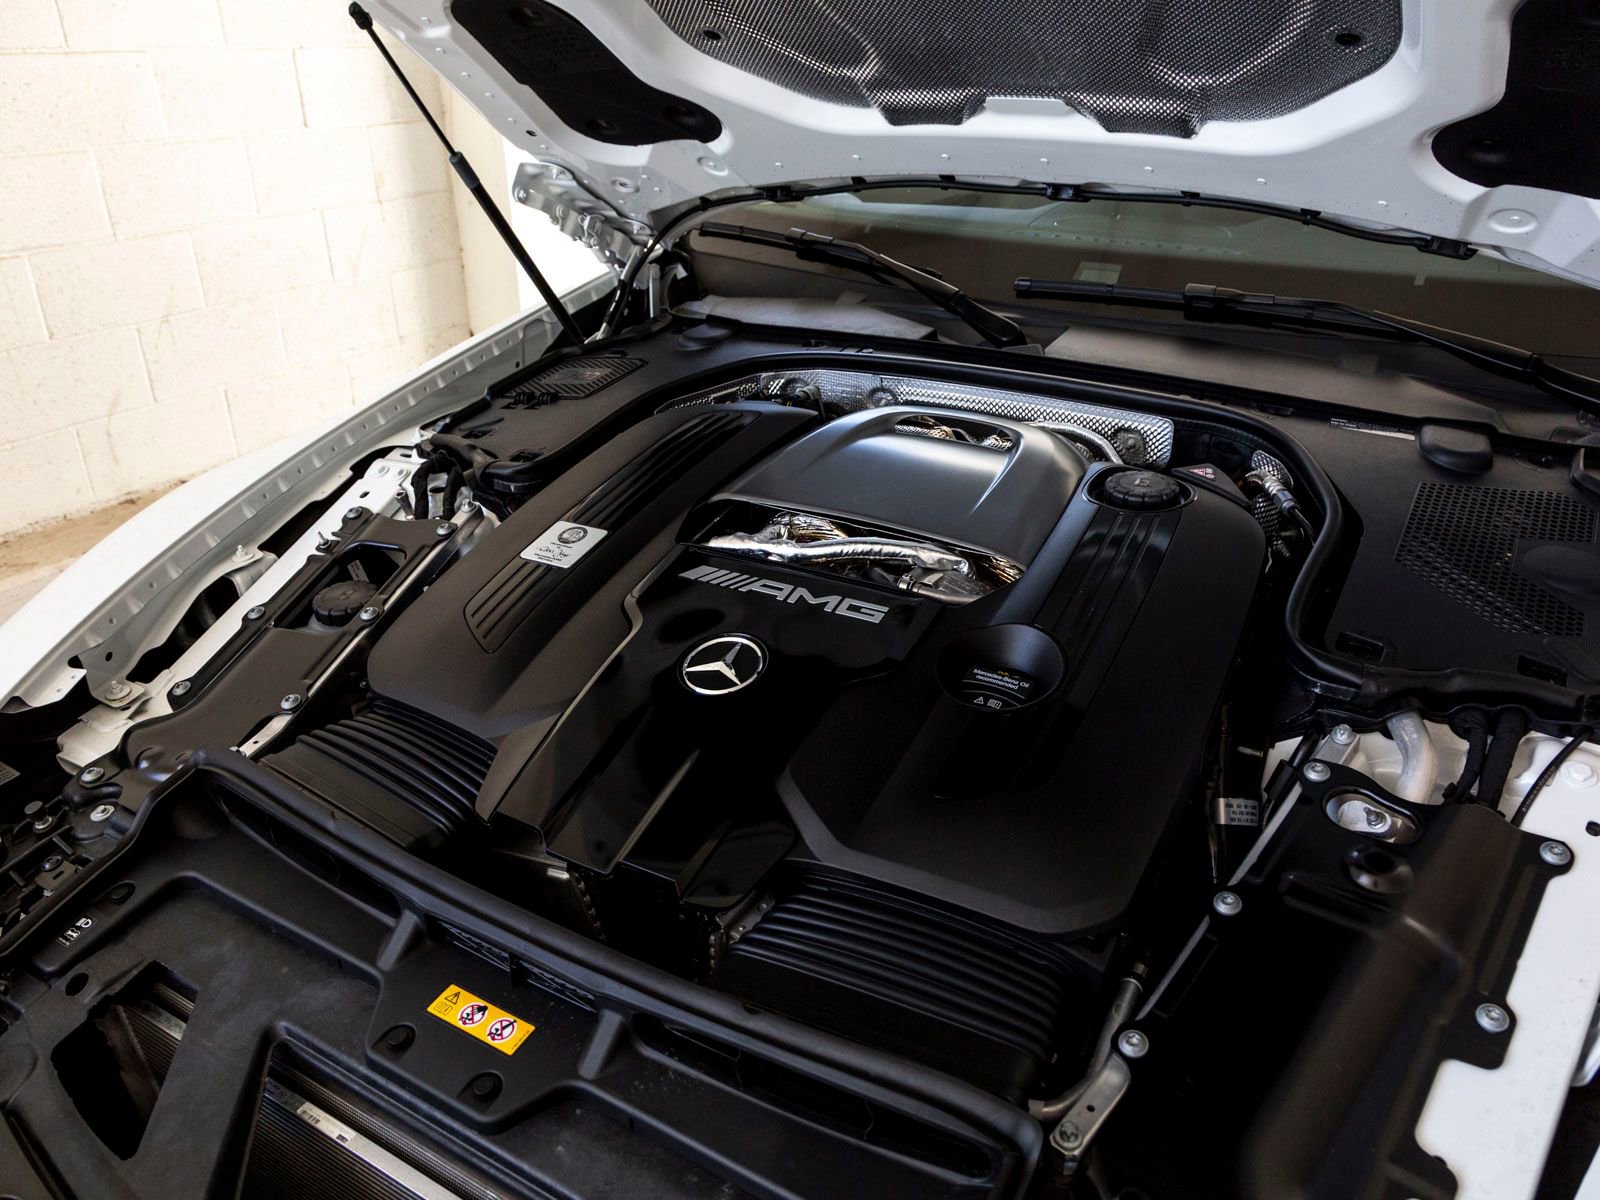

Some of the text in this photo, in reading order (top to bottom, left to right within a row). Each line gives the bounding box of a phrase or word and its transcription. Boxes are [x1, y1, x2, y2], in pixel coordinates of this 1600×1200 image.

[738, 578, 890, 624] AMG
[973, 668, 1019, 685] Mercedes-Benz
[976, 675, 1019, 690] recommended
